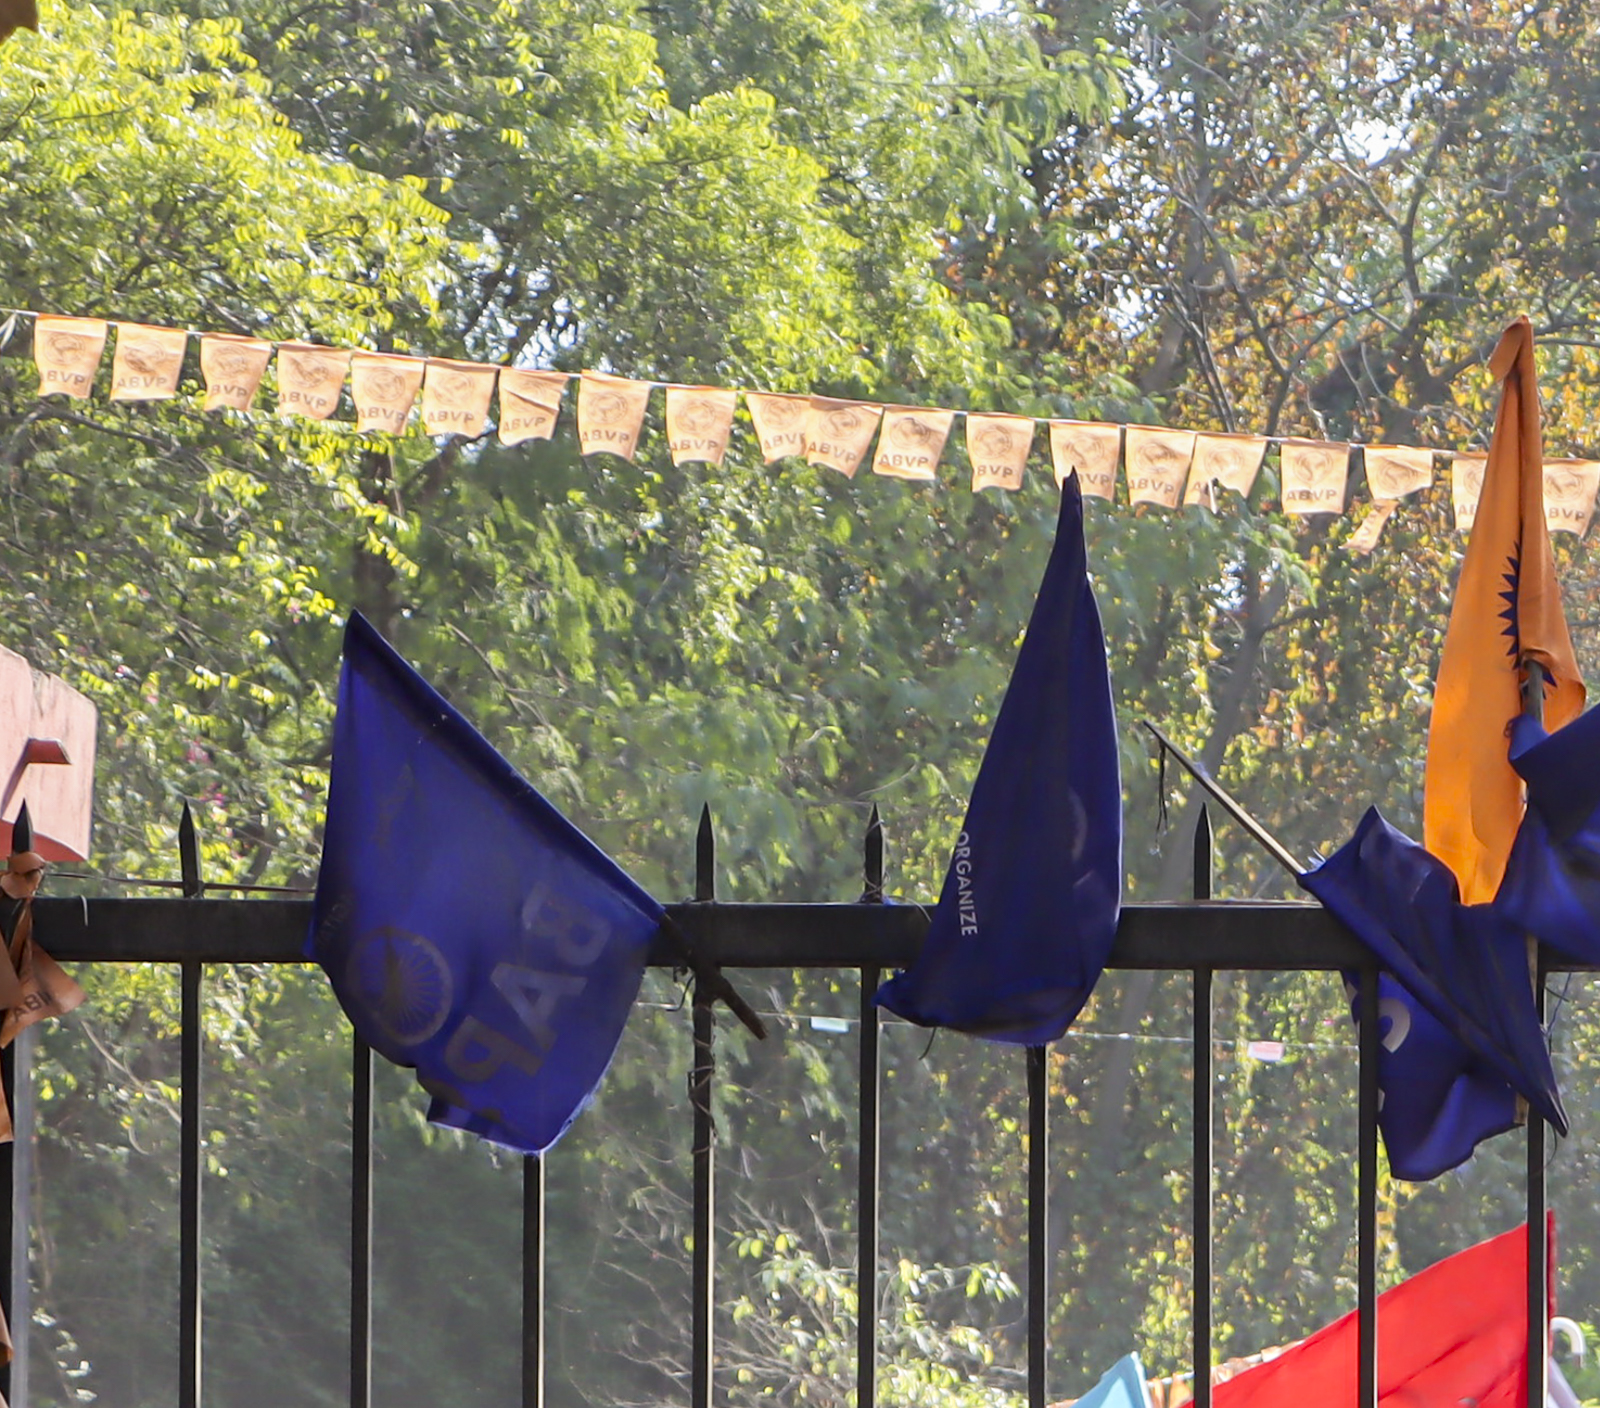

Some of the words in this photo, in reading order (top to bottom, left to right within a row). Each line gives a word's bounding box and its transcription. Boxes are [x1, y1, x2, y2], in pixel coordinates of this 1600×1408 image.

[808, 442, 857, 462] ABVP
[879, 454, 928, 467] ABVP
[955, 831, 978, 937] ORGANIZE
